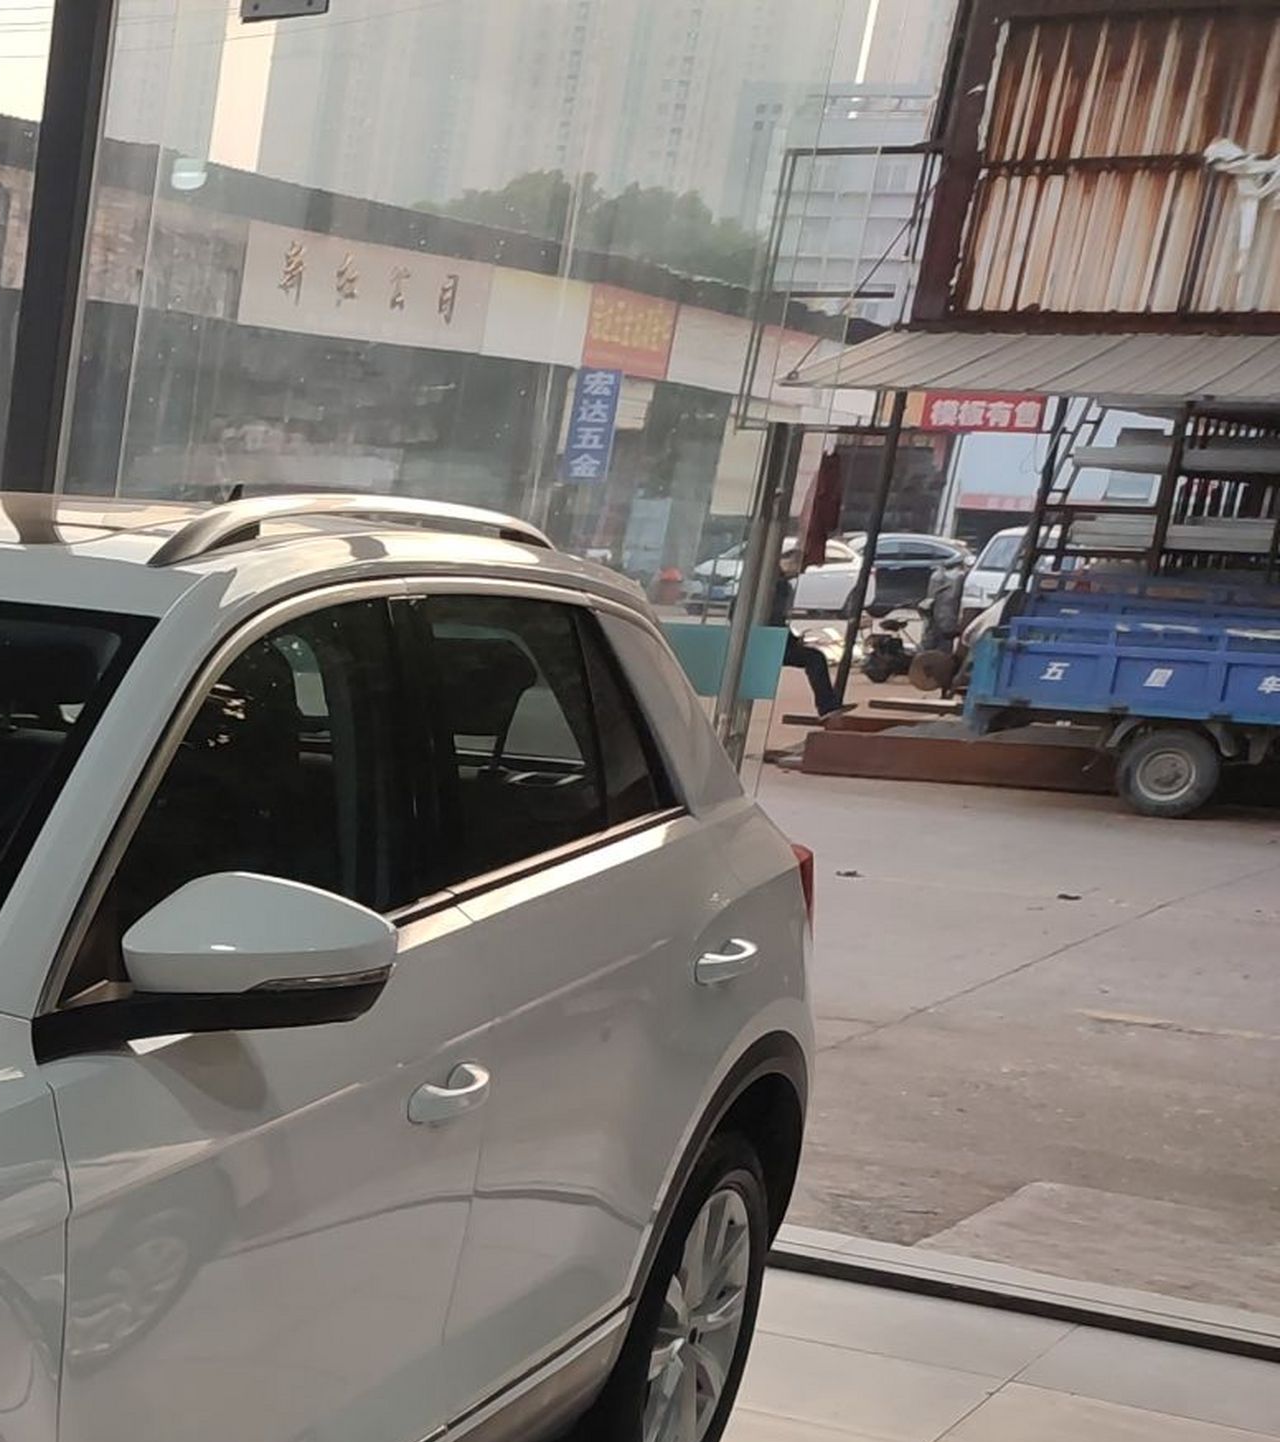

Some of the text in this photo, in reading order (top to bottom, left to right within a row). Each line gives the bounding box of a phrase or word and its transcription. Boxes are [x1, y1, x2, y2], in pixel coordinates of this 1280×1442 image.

[569, 371, 615, 478] 宏达五金
[929, 399, 1041, 427] 模板有售
